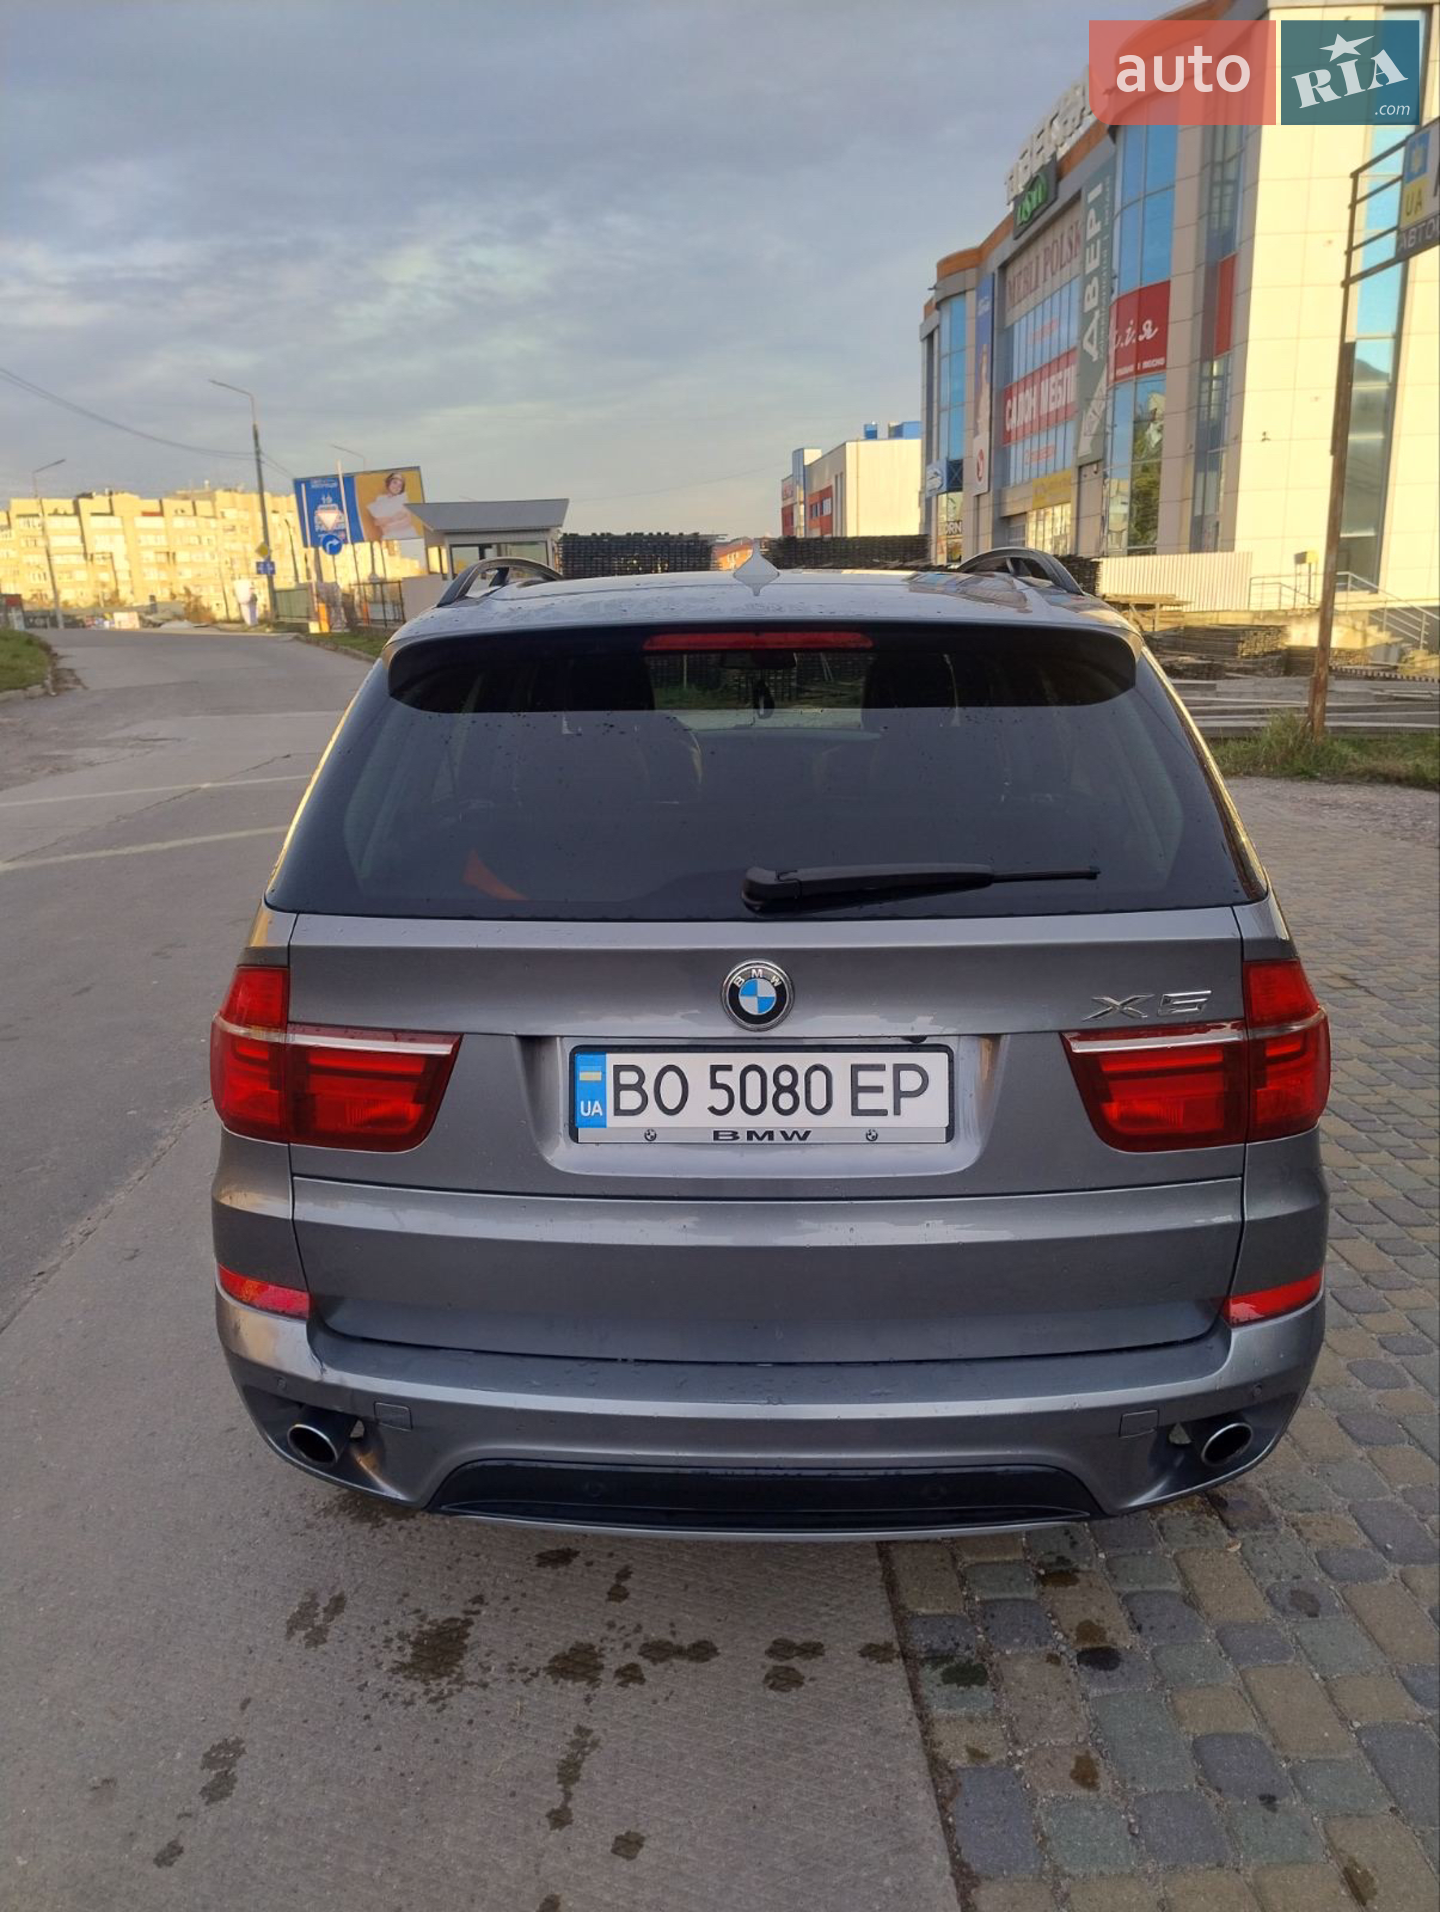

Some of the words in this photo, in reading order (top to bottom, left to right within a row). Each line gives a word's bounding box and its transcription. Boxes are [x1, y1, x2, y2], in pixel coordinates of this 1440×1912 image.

[1405, 190, 1423, 216] UA
[1005, 385, 1037, 432] САЛОН
[733, 967, 783, 988] BMW
[1082, 990, 1212, 1022] X5
[612, 1064, 689, 1117] BO
[708, 1063, 833, 1117] 5080
[850, 1063, 930, 1117] EP
[580, 1101, 603, 1117] UA
[712, 1129, 813, 1142] BMW
